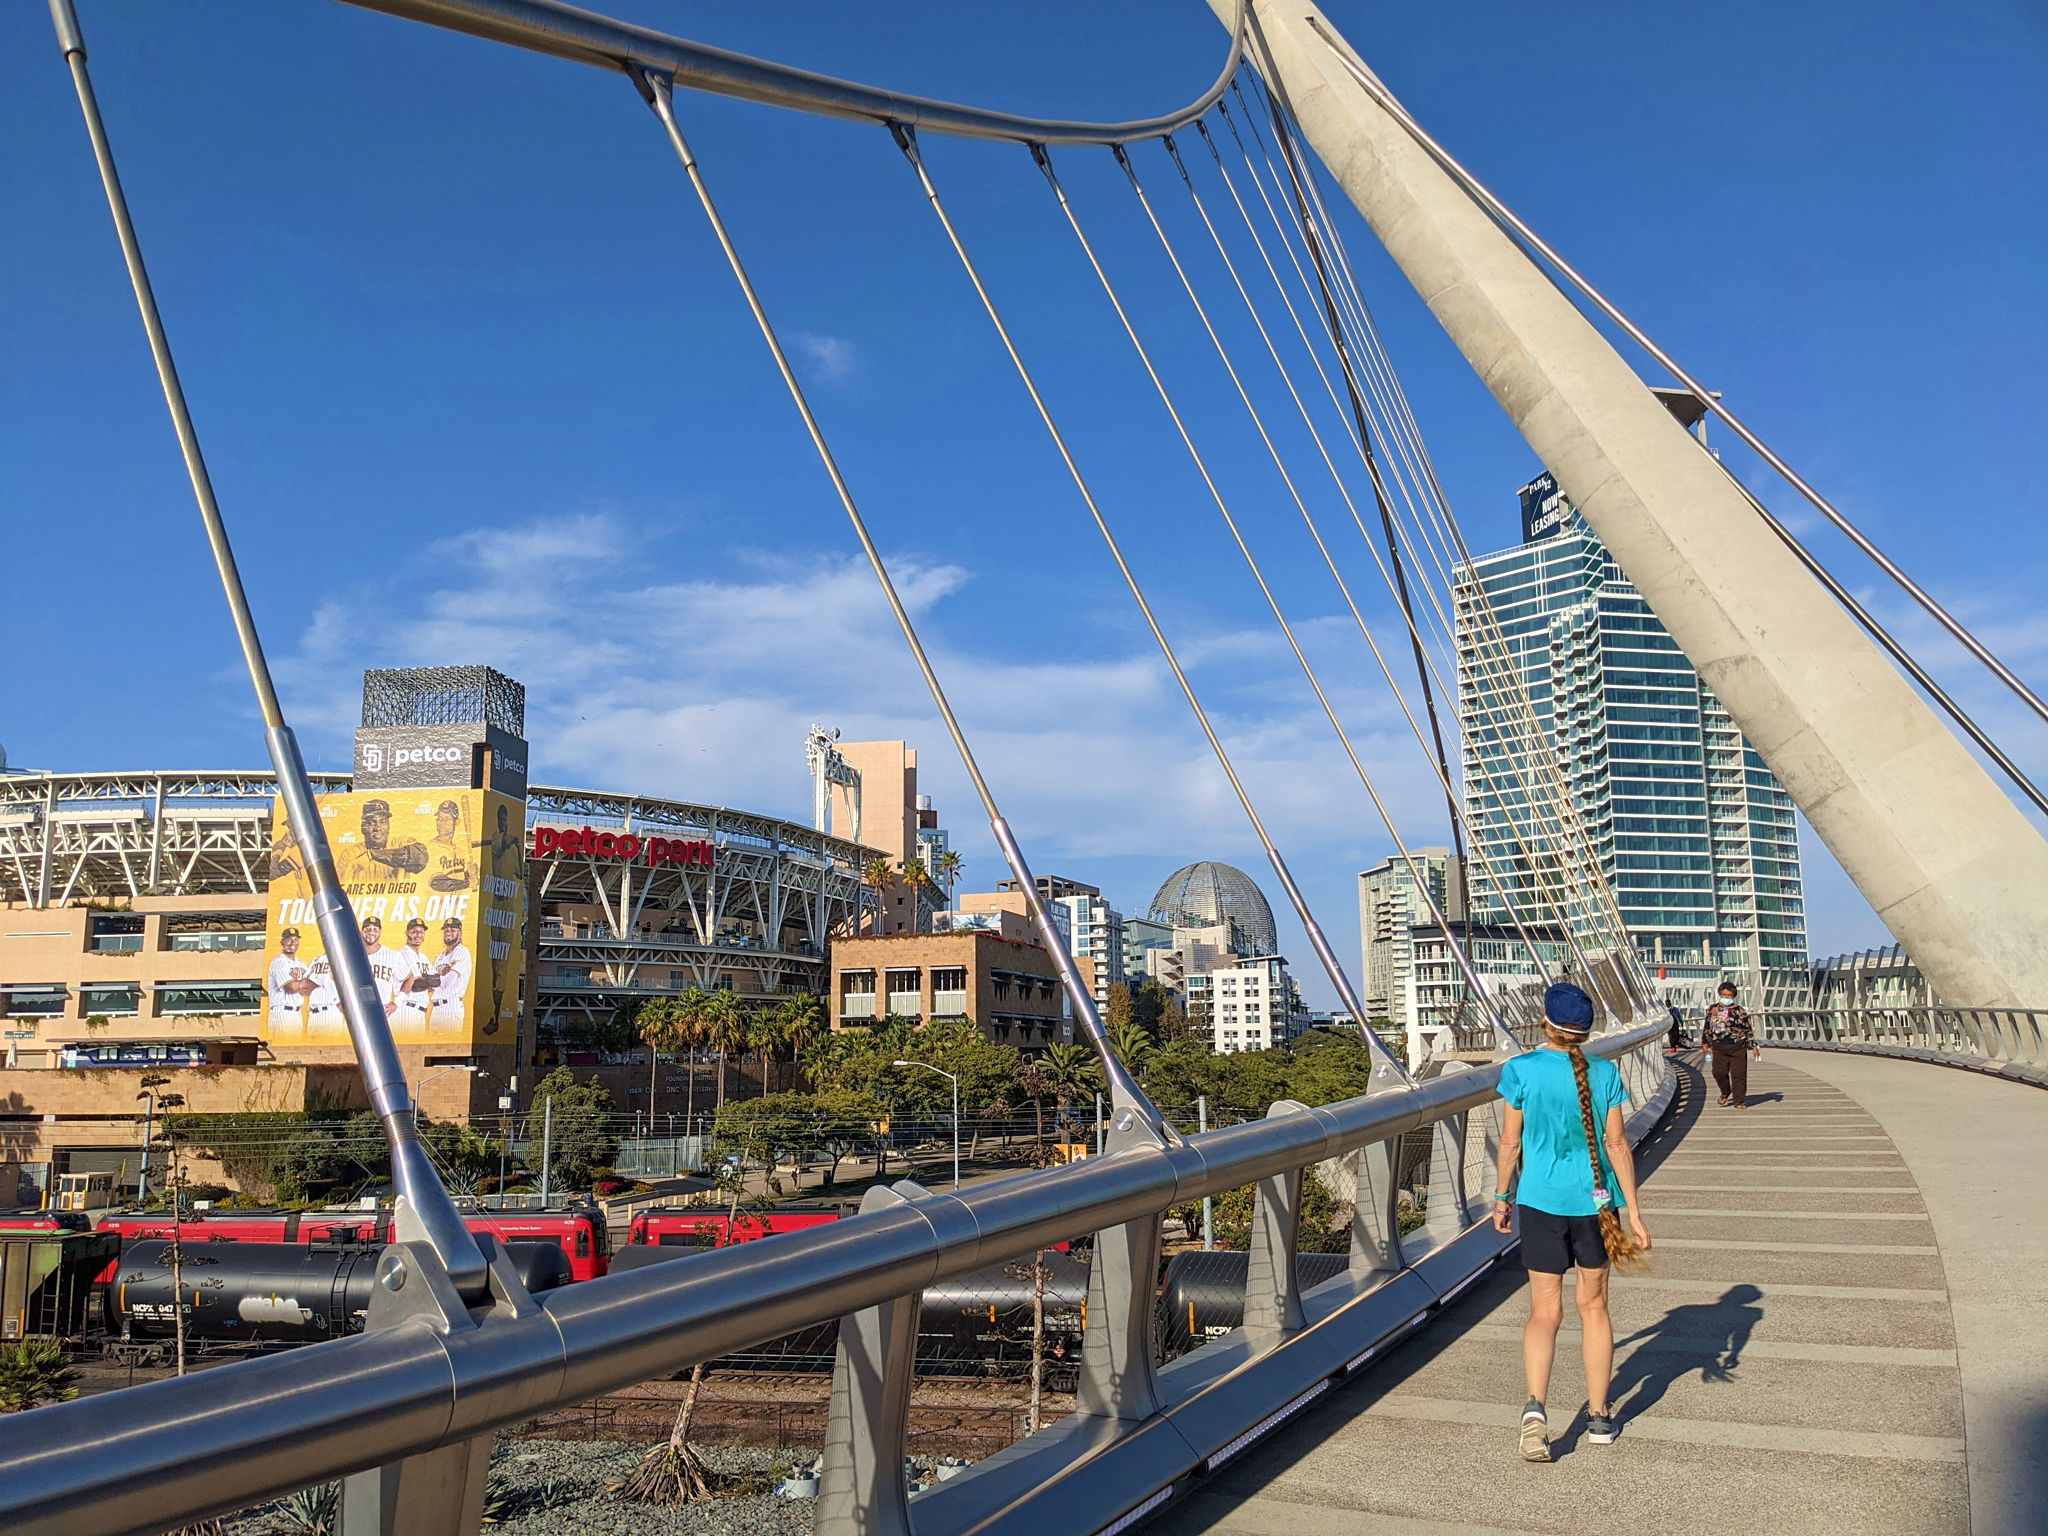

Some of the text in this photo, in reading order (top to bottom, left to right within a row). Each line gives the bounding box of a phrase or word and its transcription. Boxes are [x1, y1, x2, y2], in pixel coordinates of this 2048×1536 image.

[1542, 493, 1558, 514] NOW
[1531, 508, 1560, 537] LEASING
[395, 745, 461, 766] petco
[504, 756, 525, 775] petco
[534, 826, 715, 867] petco park
[346, 882, 417, 896] ARE SAN DIEGO
[483, 874, 520, 898] DIVERSITY
[390, 895, 420, 922] AS
[424, 893, 470, 921] ONE
[483, 907, 517, 930] EQUALITY
[488, 940, 510, 960] UNITY
[132, 1304, 155, 1312] NCPX
[1205, 1326, 1232, 1335] NCPX
